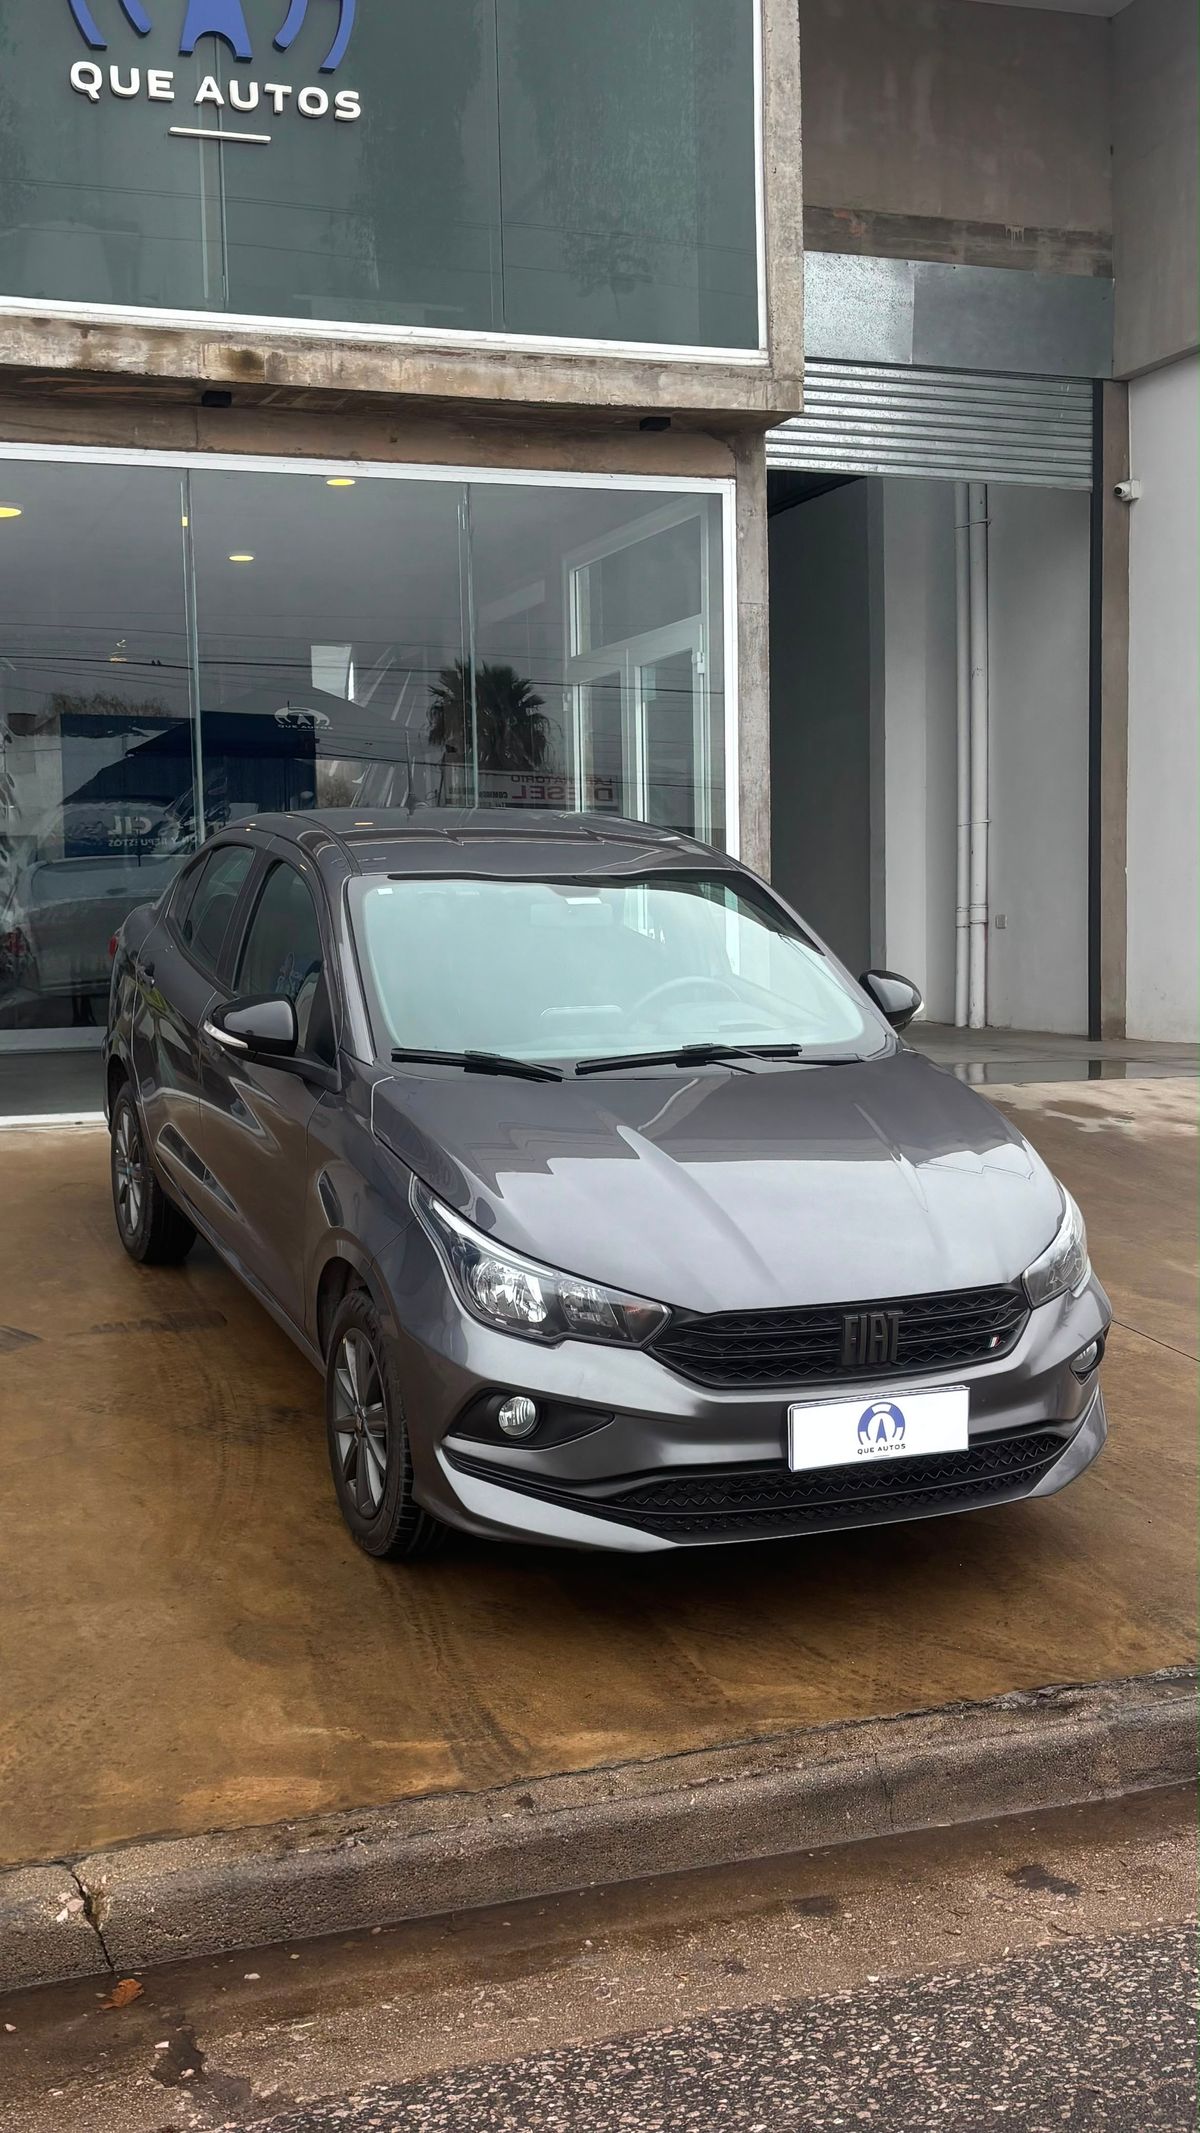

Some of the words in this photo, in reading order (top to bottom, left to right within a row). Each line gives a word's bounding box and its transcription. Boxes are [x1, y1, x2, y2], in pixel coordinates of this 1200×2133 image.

[70, 61, 175, 102] QUE
[194, 76, 362, 122] AUTOS
[841, 1311, 904, 1366] FIAT
[857, 1447, 875, 1456] QUE
[877, 1443, 906, 1452] AUTOS
